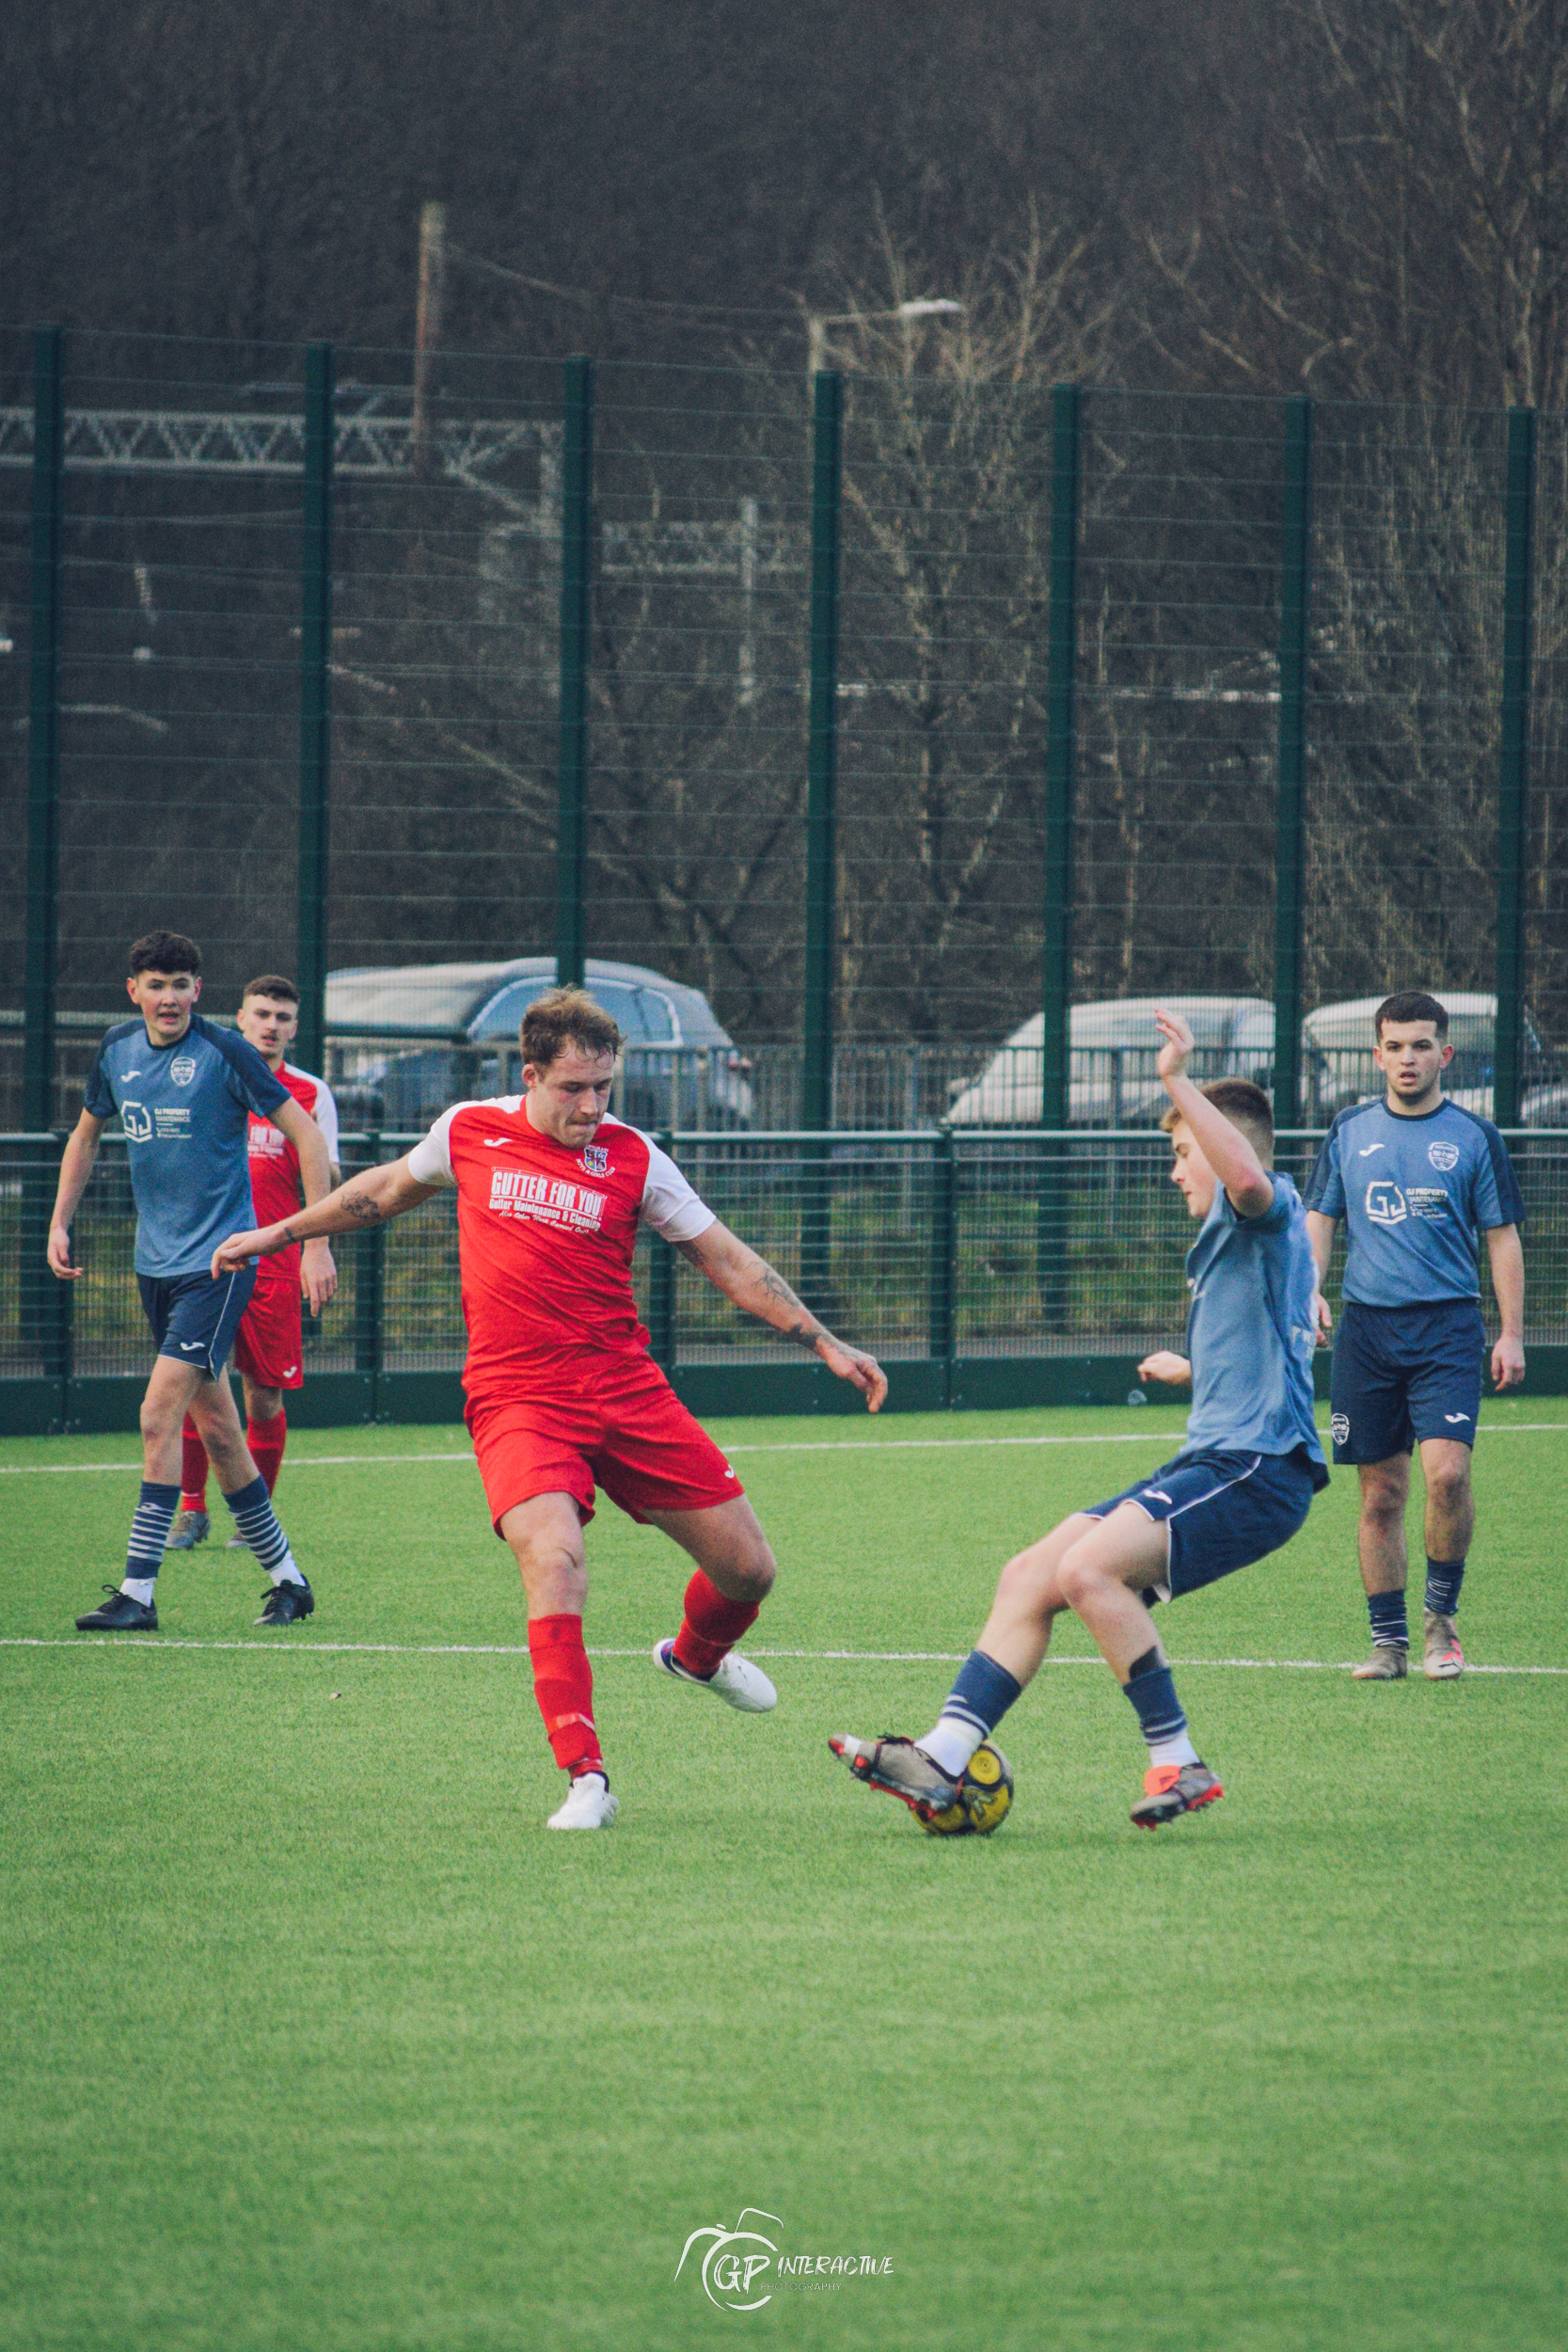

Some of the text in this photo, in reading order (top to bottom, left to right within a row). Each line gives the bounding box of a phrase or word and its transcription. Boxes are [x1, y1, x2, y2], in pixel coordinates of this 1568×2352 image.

[491, 1171, 548, 1201] GUTTER
[548, 1182, 577, 1208] FOR
[1416, 1188, 1449, 1197] PROPERTY
[488, 1198, 601, 1232] Gutter Maintenance & Cleaning
[514, 1212, 531, 1220] Other
[550, 1219, 575, 1232] Carried
